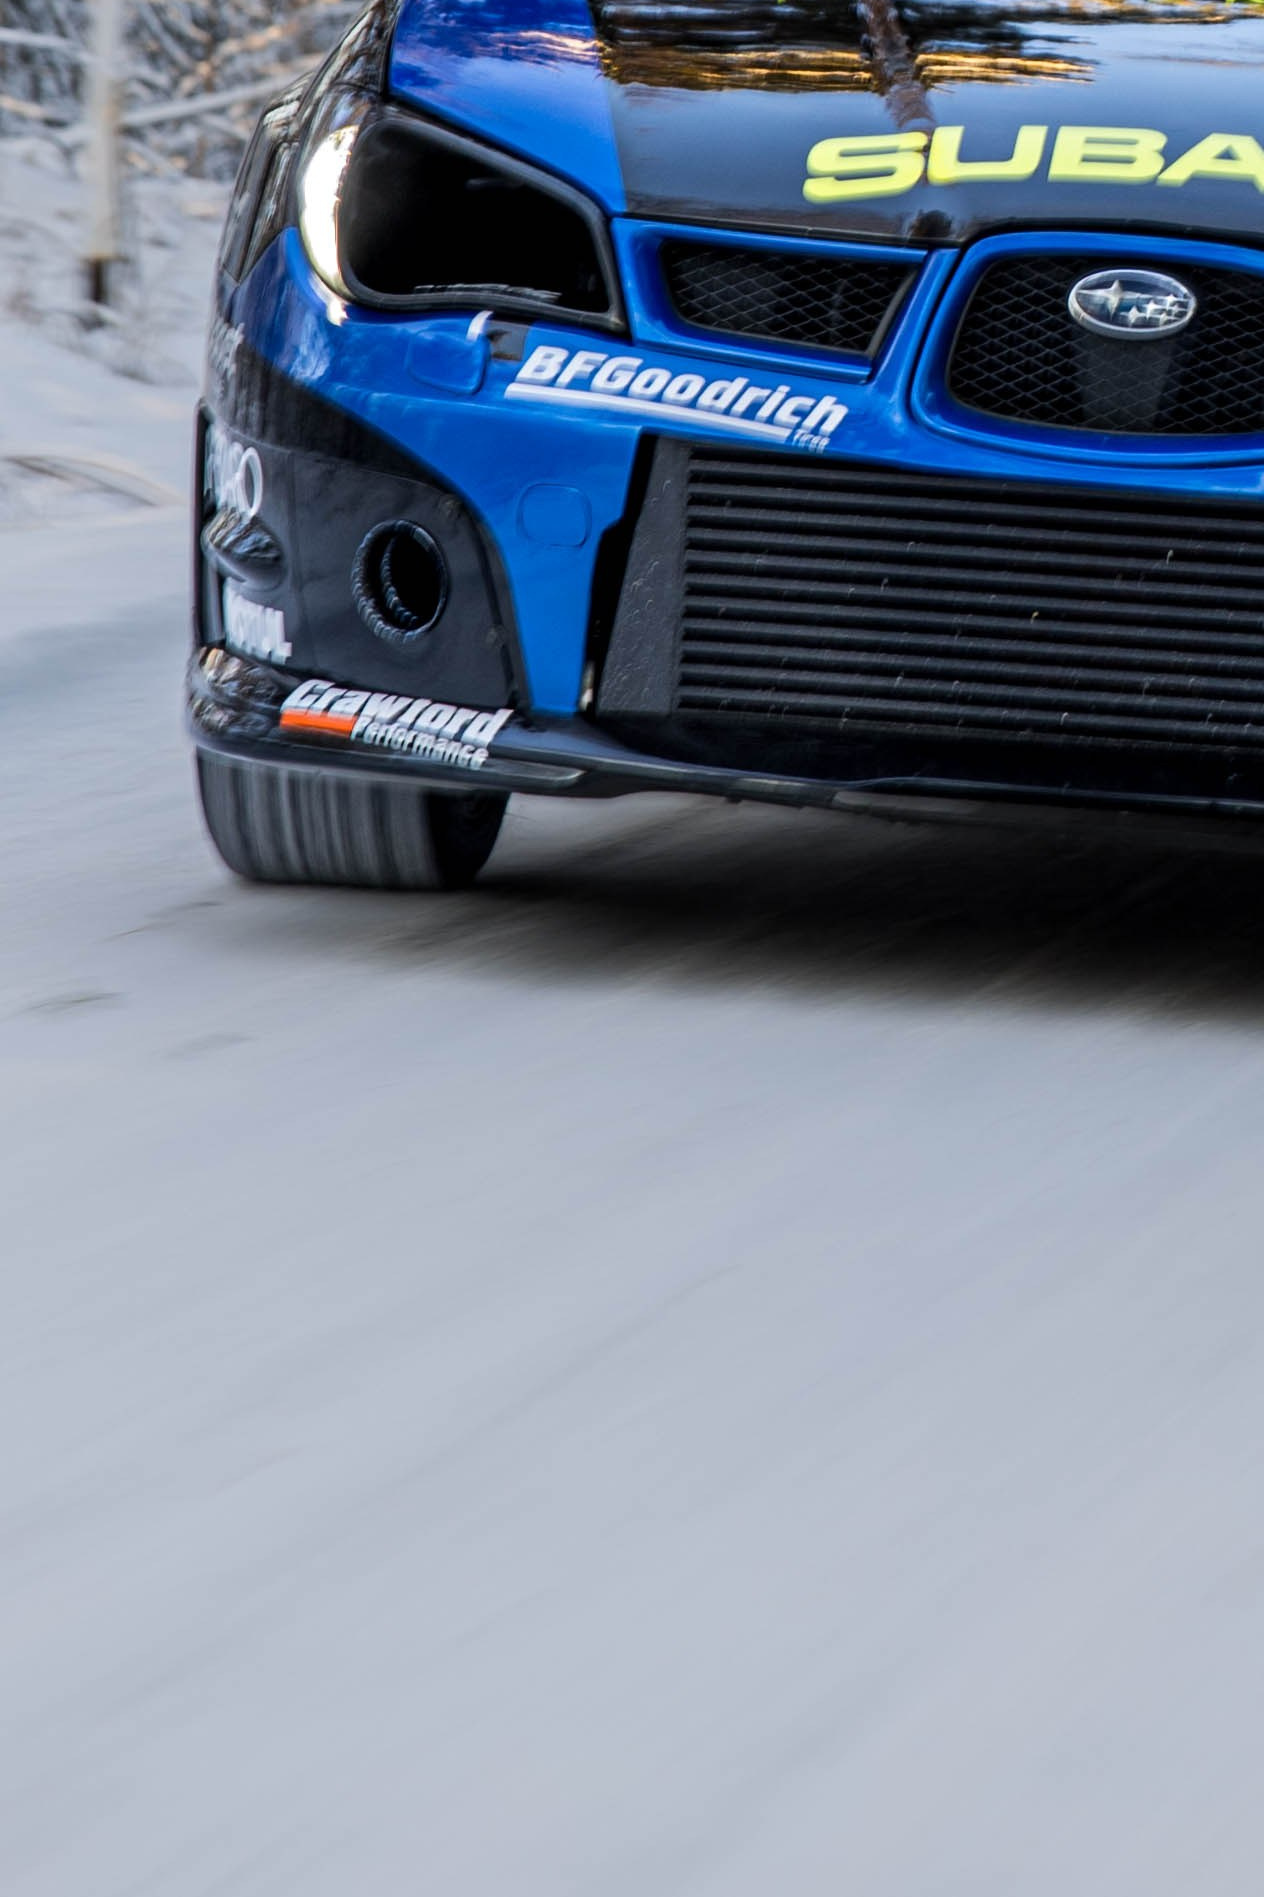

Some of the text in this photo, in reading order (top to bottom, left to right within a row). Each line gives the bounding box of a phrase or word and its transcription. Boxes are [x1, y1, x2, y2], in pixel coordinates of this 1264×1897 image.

[514, 345, 849, 438] BFGoodrich
[280, 678, 515, 749] Crawford
[350, 715, 489, 770] Performance
